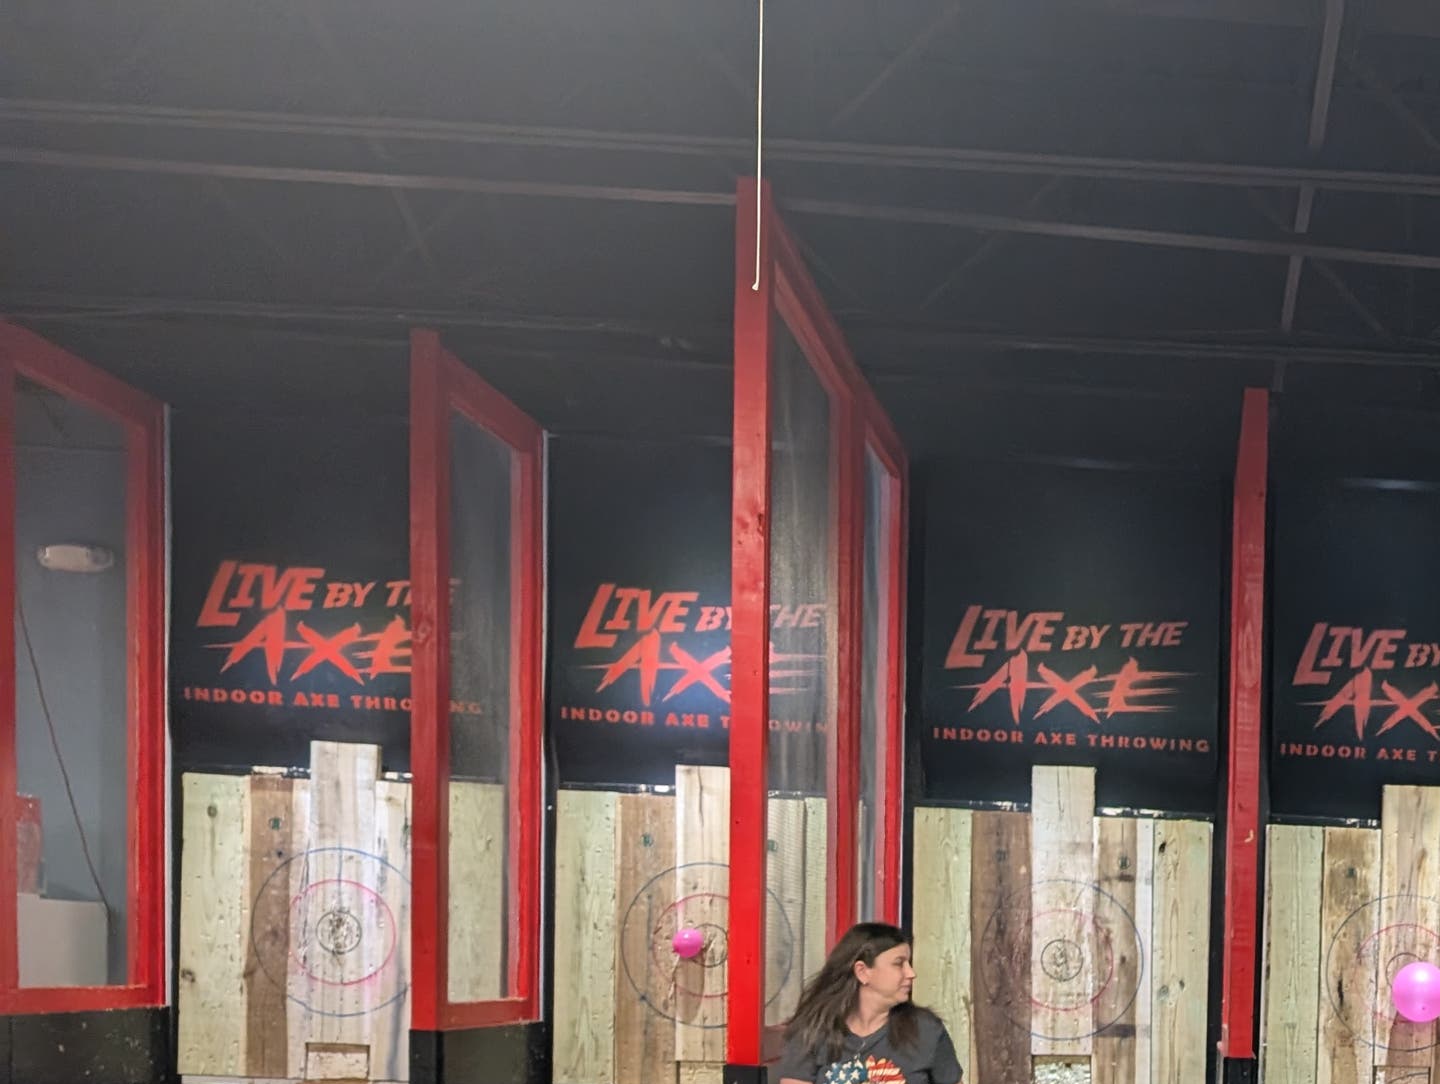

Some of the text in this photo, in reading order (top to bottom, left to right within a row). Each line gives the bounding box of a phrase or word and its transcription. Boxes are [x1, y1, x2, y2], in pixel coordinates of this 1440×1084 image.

[196, 560, 326, 627] LIVE
[323, 581, 376, 608] BY
[574, 583, 700, 648] LIVE
[200, 606, 464, 685] AXE
[944, 605, 1189, 669] LIVE BY THE
[1292, 621, 1408, 686] LIVE
[183, 687, 284, 706] INDOOR
[294, 692, 340, 708] AXE
[560, 706, 655, 726] INDOOR
[665, 710, 710, 729] AXE
[949, 648, 1199, 725] AXE
[932, 727, 1211, 753] INDOOR AXE THROWING
[1279, 743, 1367, 760] INDOOR
[1376, 747, 1416, 761] AXE
